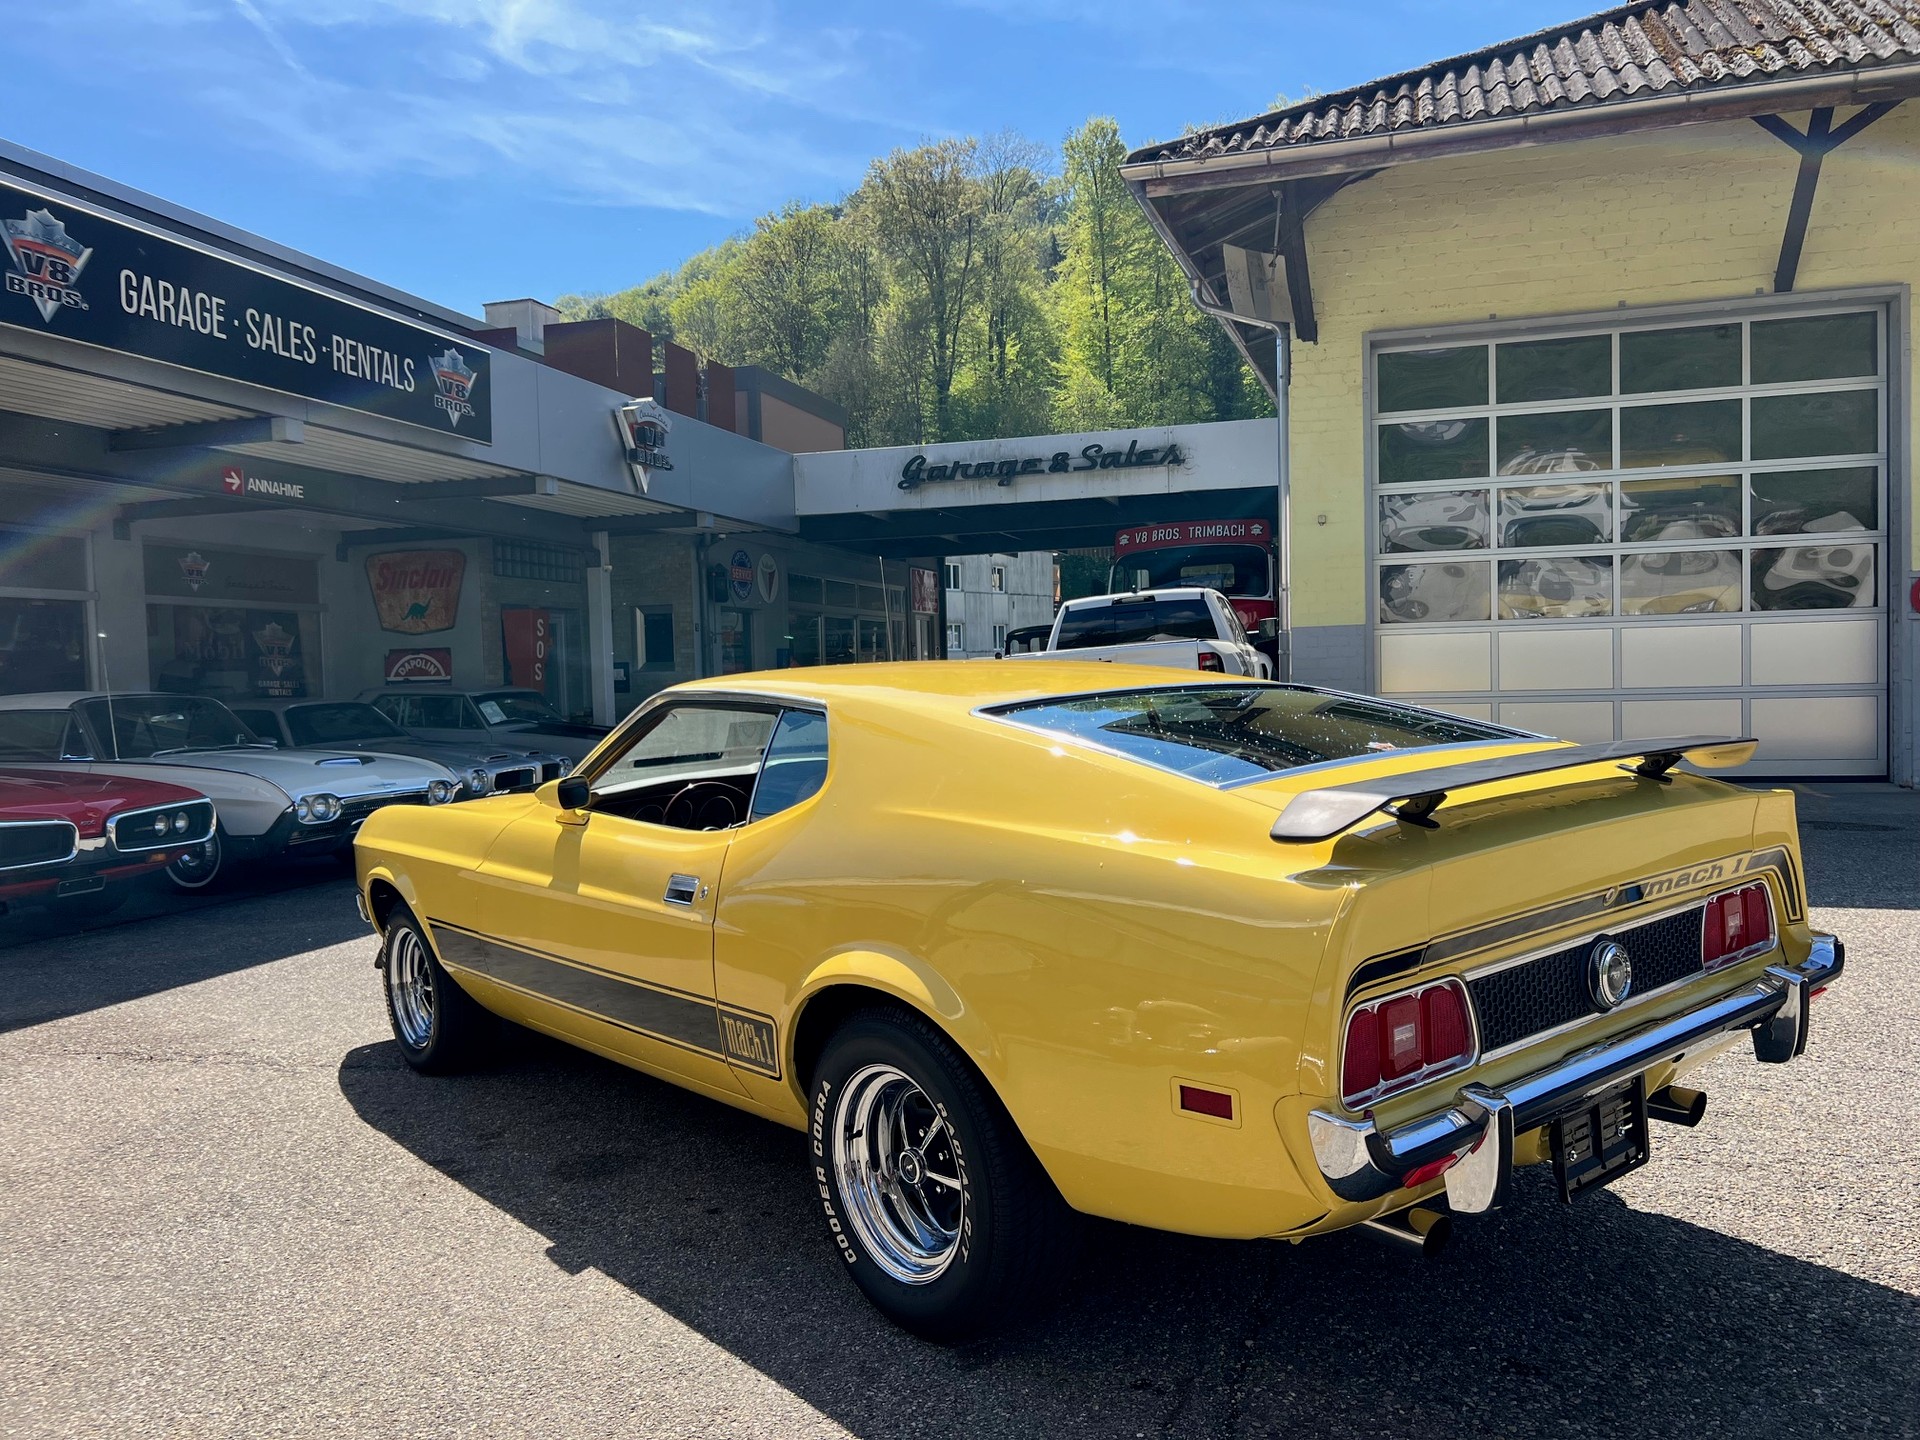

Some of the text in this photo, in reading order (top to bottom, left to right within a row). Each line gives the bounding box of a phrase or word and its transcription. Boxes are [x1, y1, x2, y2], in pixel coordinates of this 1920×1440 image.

[19, 247, 72, 286] V8
[120, 269, 415, 393] GARAGE SALES RENTALS
[440, 377, 467, 401] V8
[898, 440, 1186, 489] Garage & Sales
[248, 478, 304, 499] ANNAHME
[1135, 533, 1148, 544] V8
[1152, 528, 1182, 542] BROS.
[1188, 524, 1245, 539] TRIMBACH
[376, 561, 457, 591] Sinclair
[732, 568, 753, 581] SERVICE
[398, 659, 437, 676] DAPOLIN
[1645, 858, 1744, 898] mach 1
[936, 1102, 971, 1206] RADIAL
[813, 1080, 857, 1264] COOPER COBRA
